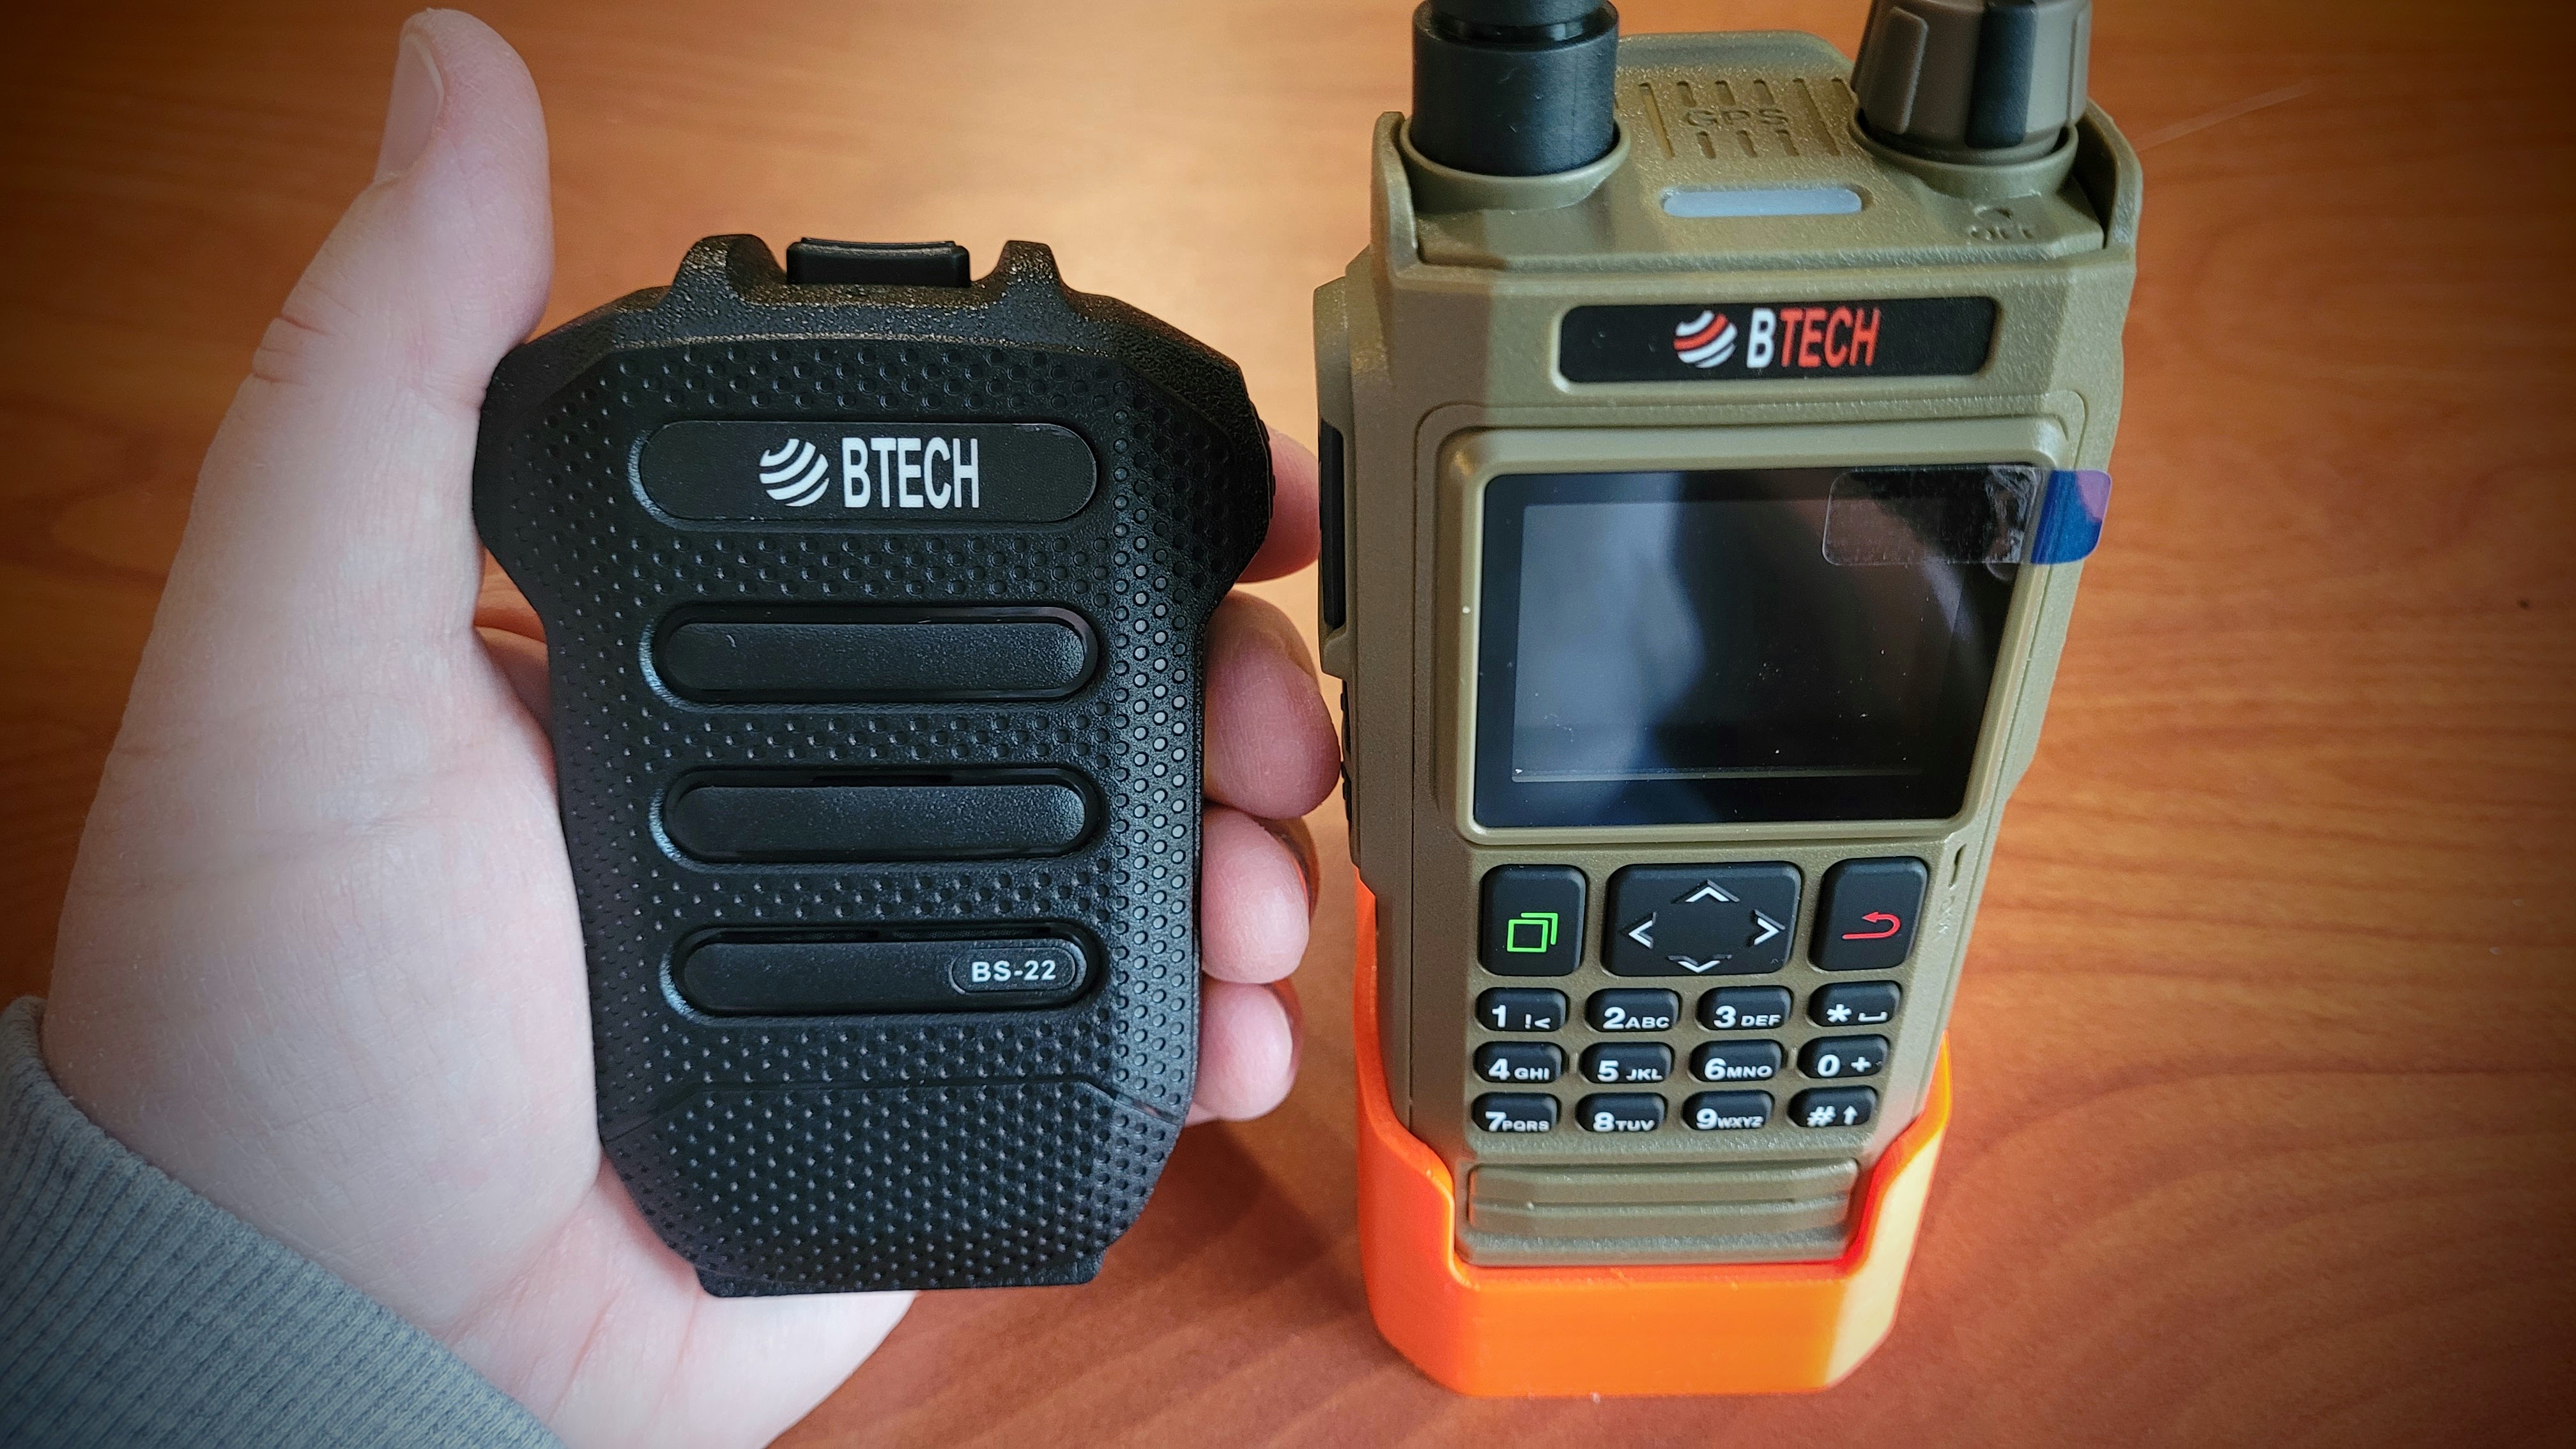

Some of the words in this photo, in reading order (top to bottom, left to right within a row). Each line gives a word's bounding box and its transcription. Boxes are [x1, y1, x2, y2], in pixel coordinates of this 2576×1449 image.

[1683, 107, 1788, 126] GPS
[1747, 307, 1881, 368] BTECH
[842, 436, 979, 509] BTECH
[972, 960, 1056, 983] BS-22
[1492, 1004, 1506, 1028] 1
[1713, 1005, 1736, 1028] 3
[1740, 1015, 1781, 1027] DEF
[1597, 1060, 1619, 1082] 5
